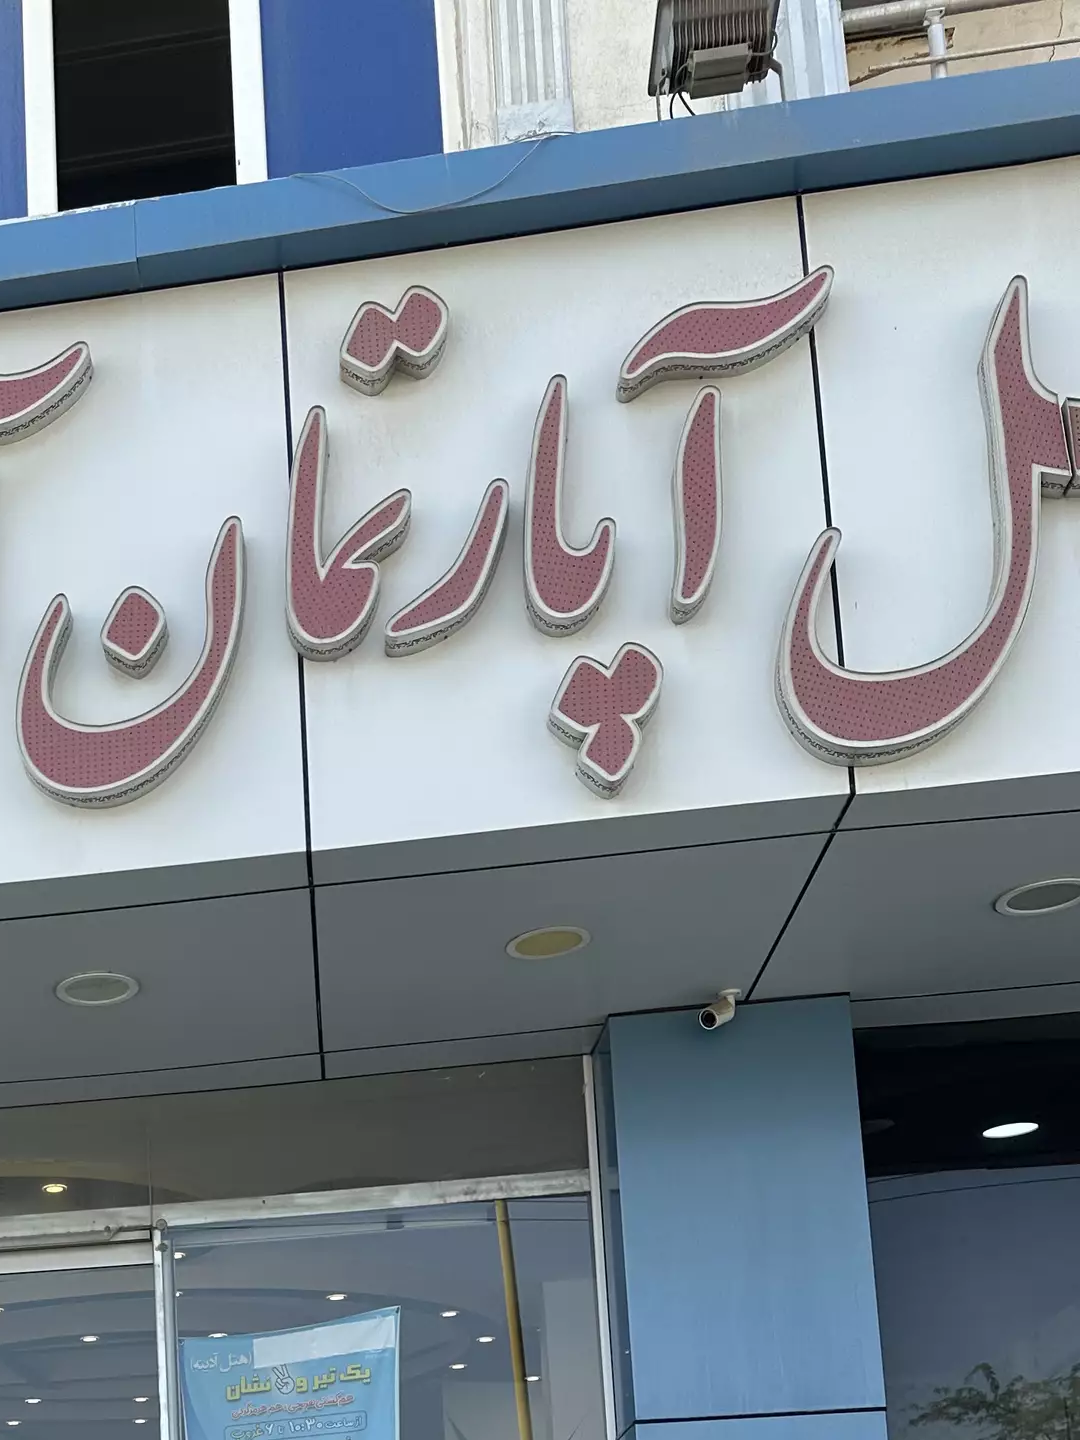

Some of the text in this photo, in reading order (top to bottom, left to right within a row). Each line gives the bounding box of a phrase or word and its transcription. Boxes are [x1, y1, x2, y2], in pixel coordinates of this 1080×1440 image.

[15, 264, 835, 808] آپارتمان
[226, 1363, 372, 1401] یک تیر و نشان
[265, 1423, 274, 1435] ۶
[325, 1416, 354, 1429] ساعت
